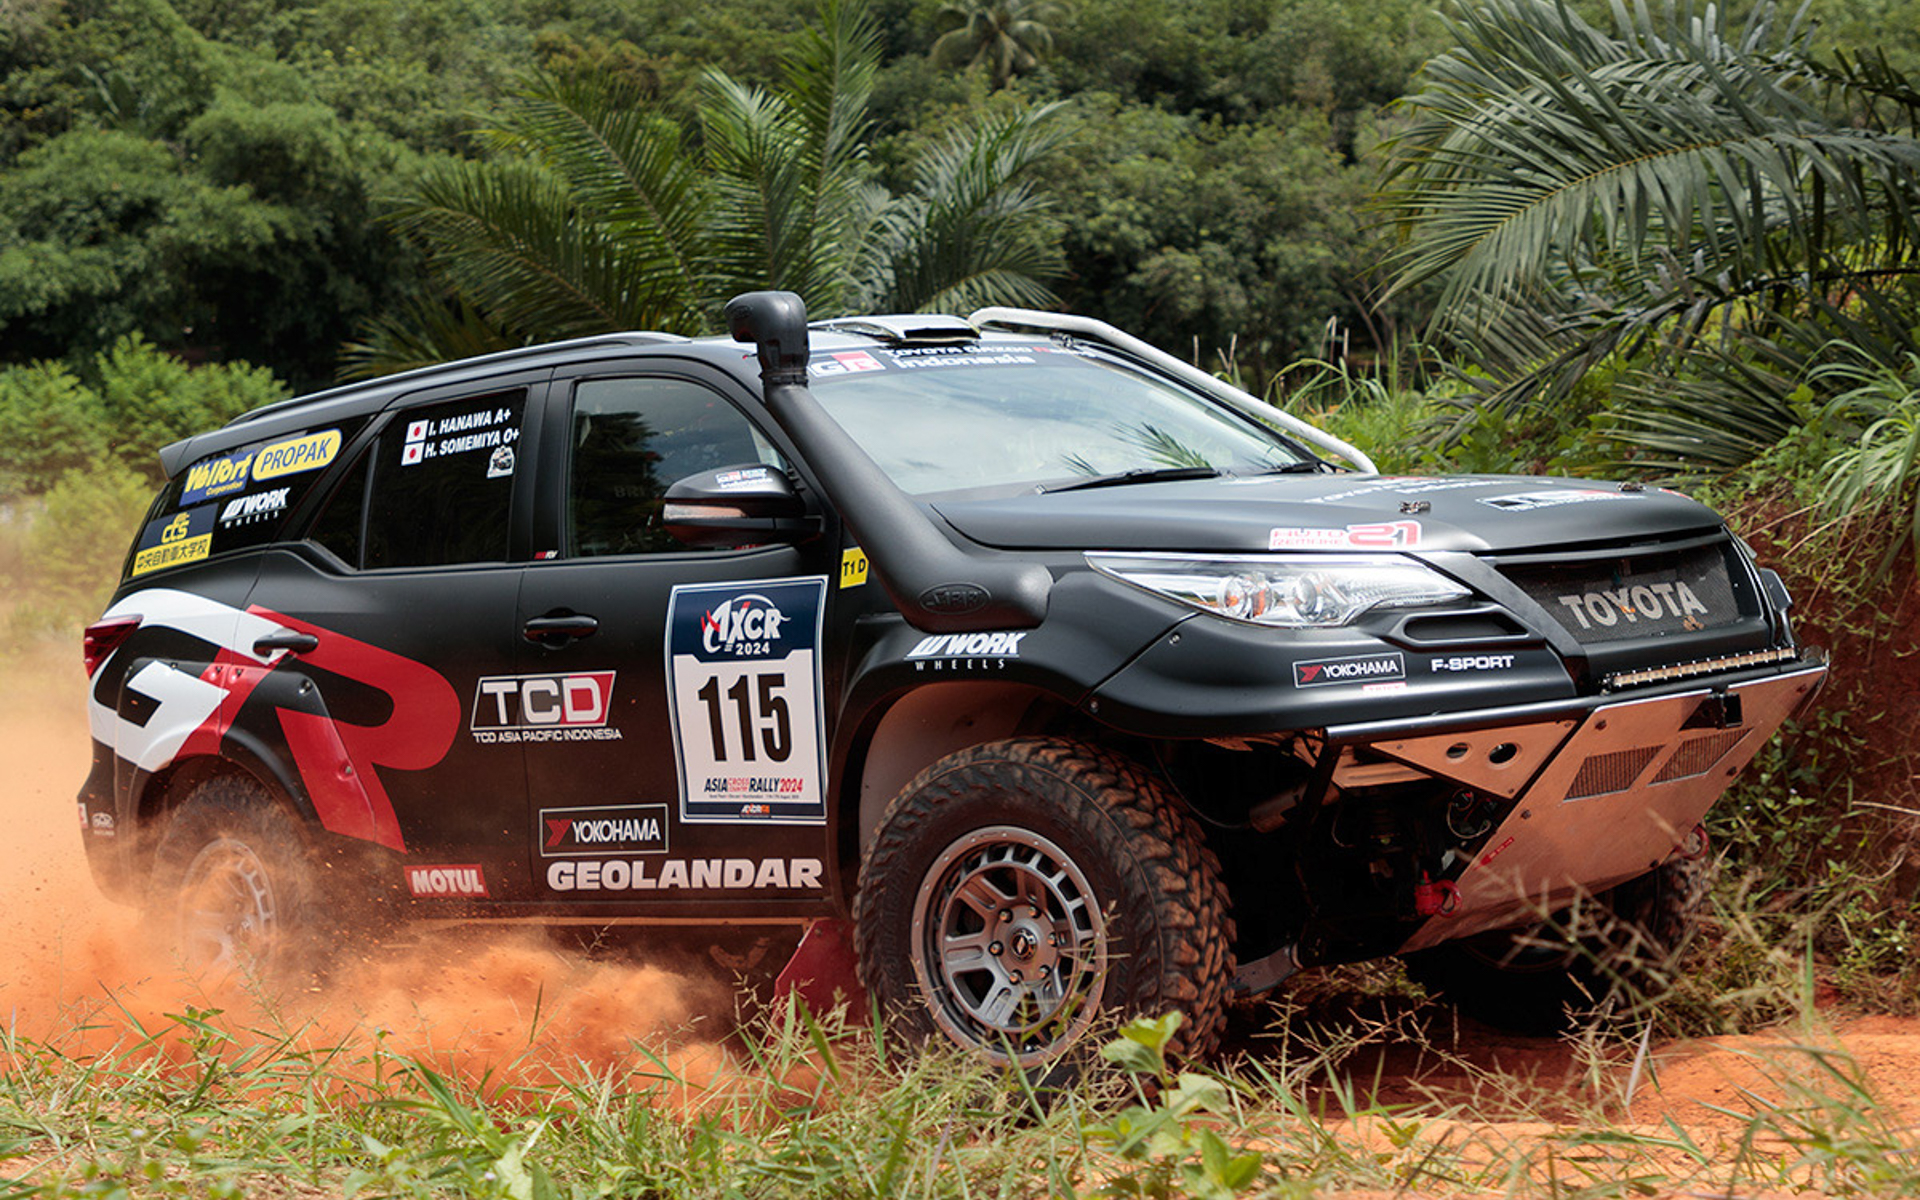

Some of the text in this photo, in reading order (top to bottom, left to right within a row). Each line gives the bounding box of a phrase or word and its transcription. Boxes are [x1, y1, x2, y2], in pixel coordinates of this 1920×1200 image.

[808, 352, 886, 377] GR
[880, 347, 960, 357] TOYOTA
[892, 354, 1036, 369] Indonesia
[439, 410, 492, 435] HANAWA
[494, 408, 512, 425] A+
[260, 437, 332, 473] PROPAK
[424, 442, 438, 459] H.
[439, 430, 501, 456] SOMEMIYA
[243, 487, 291, 515] WORK
[1348, 521, 1418, 546] 21
[1557, 581, 1708, 629] TOYOTA
[702, 599, 782, 653] AXCR
[735, 641, 771, 656] 2024
[945, 632, 1027, 655] WORK
[914, 659, 1005, 671] WHEELS
[1322, 660, 1399, 678] YOKOHAMA
[481, 677, 603, 725] TCD
[88, 588, 461, 854] GR
[698, 673, 792, 763] 115
[472, 728, 623, 743] TCD ASIA PACIFIC INDONESIA
[704, 777, 728, 792] ASIA
[749, 777, 780, 792] RALLY
[779, 778, 804, 792] 2024
[572, 818, 661, 843] YOKOHAMA
[411, 868, 483, 894] MOTUL
[546, 858, 824, 891] GEOLANDAR
